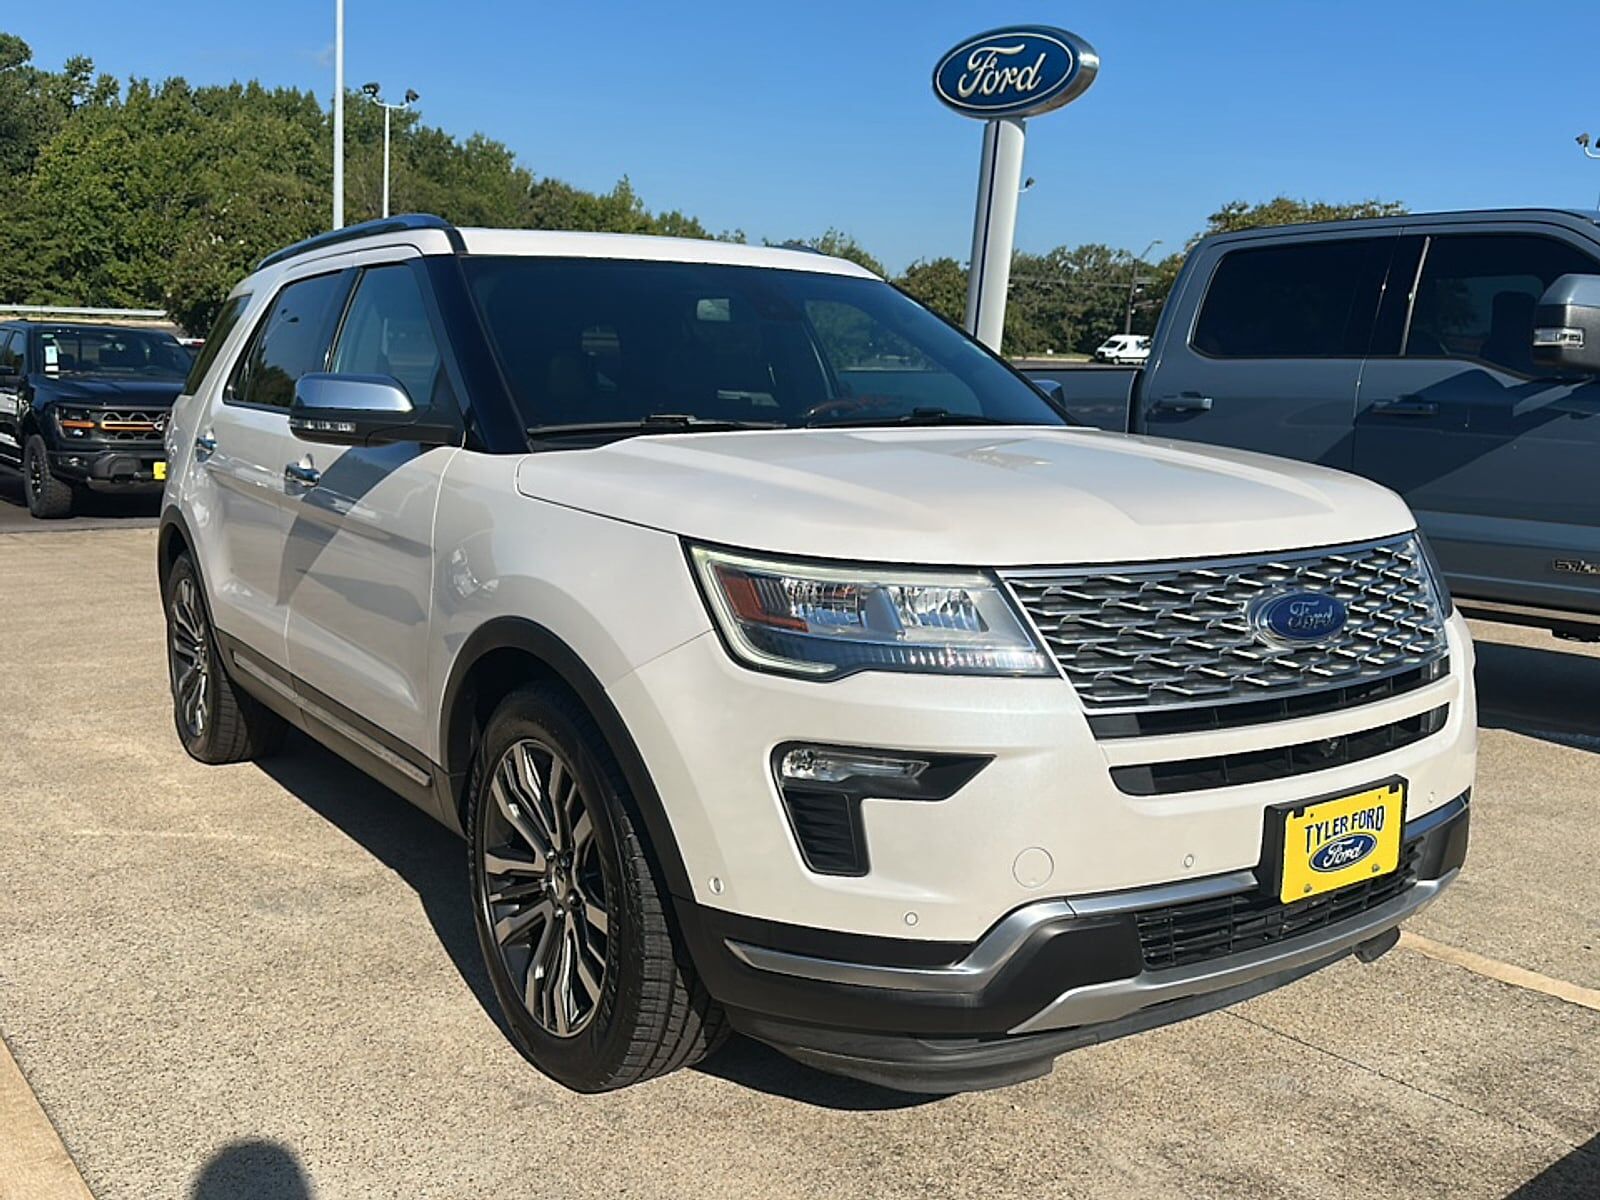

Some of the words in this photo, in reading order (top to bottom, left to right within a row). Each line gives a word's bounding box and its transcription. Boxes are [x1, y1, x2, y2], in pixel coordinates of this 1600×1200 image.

[957, 44, 1046, 98] Ford
[1288, 600, 1334, 630] Ford
[1304, 815, 1349, 854] TYLER
[1350, 805, 1385, 832] FORD
[1322, 837, 1365, 868] Ford
